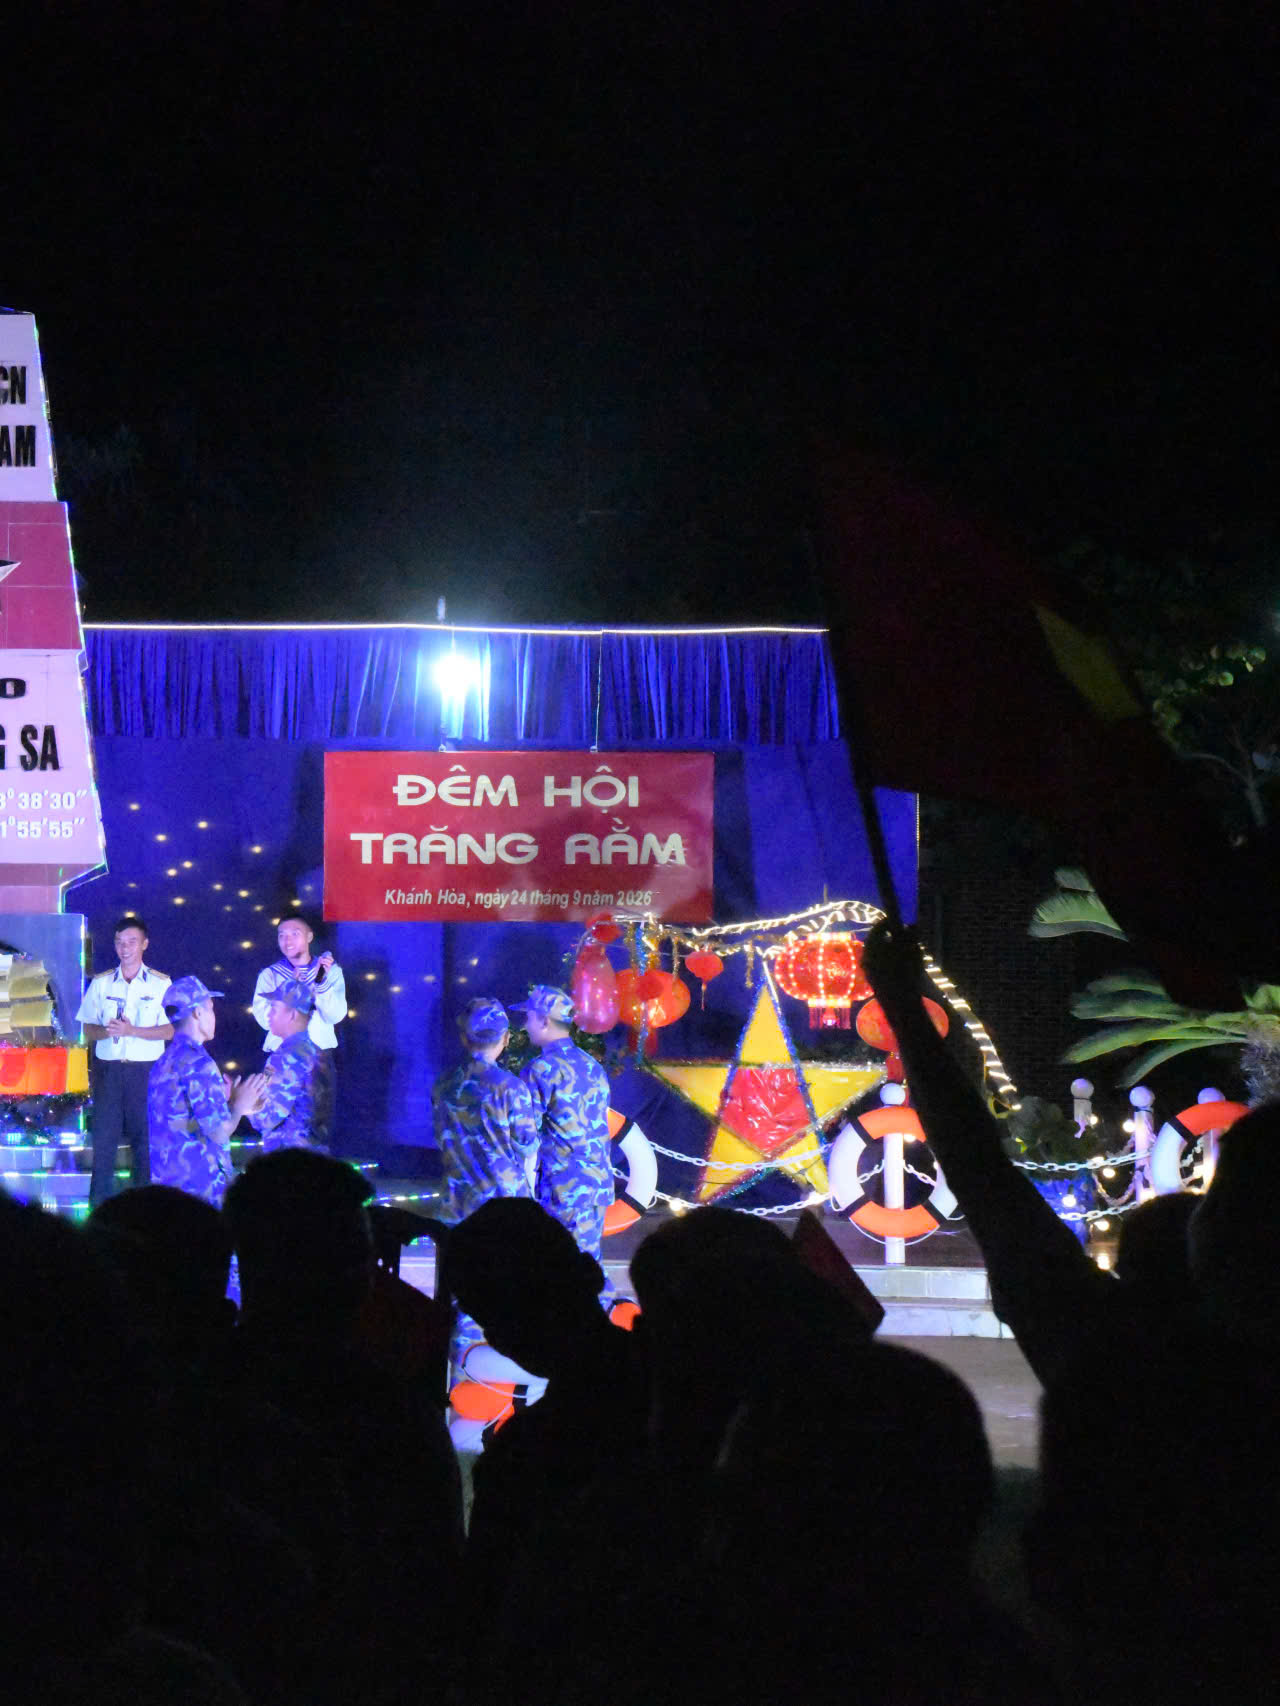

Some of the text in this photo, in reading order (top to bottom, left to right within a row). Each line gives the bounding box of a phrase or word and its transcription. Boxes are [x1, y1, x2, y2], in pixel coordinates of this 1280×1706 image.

[19, 724, 61, 771] SA
[392, 764, 639, 814] ĐÊM HỘI
[350, 817, 686, 866] TRĂNG RẰM
[384, 887, 432, 905] Khánh
[438, 887, 471, 908] Hòa,
[474, 888, 509, 909] ngày
[511, 889, 528, 905] 24
[529, 888, 569, 909] tháng
[572, 890, 580, 905] 9
[583, 889, 613, 905] năm
